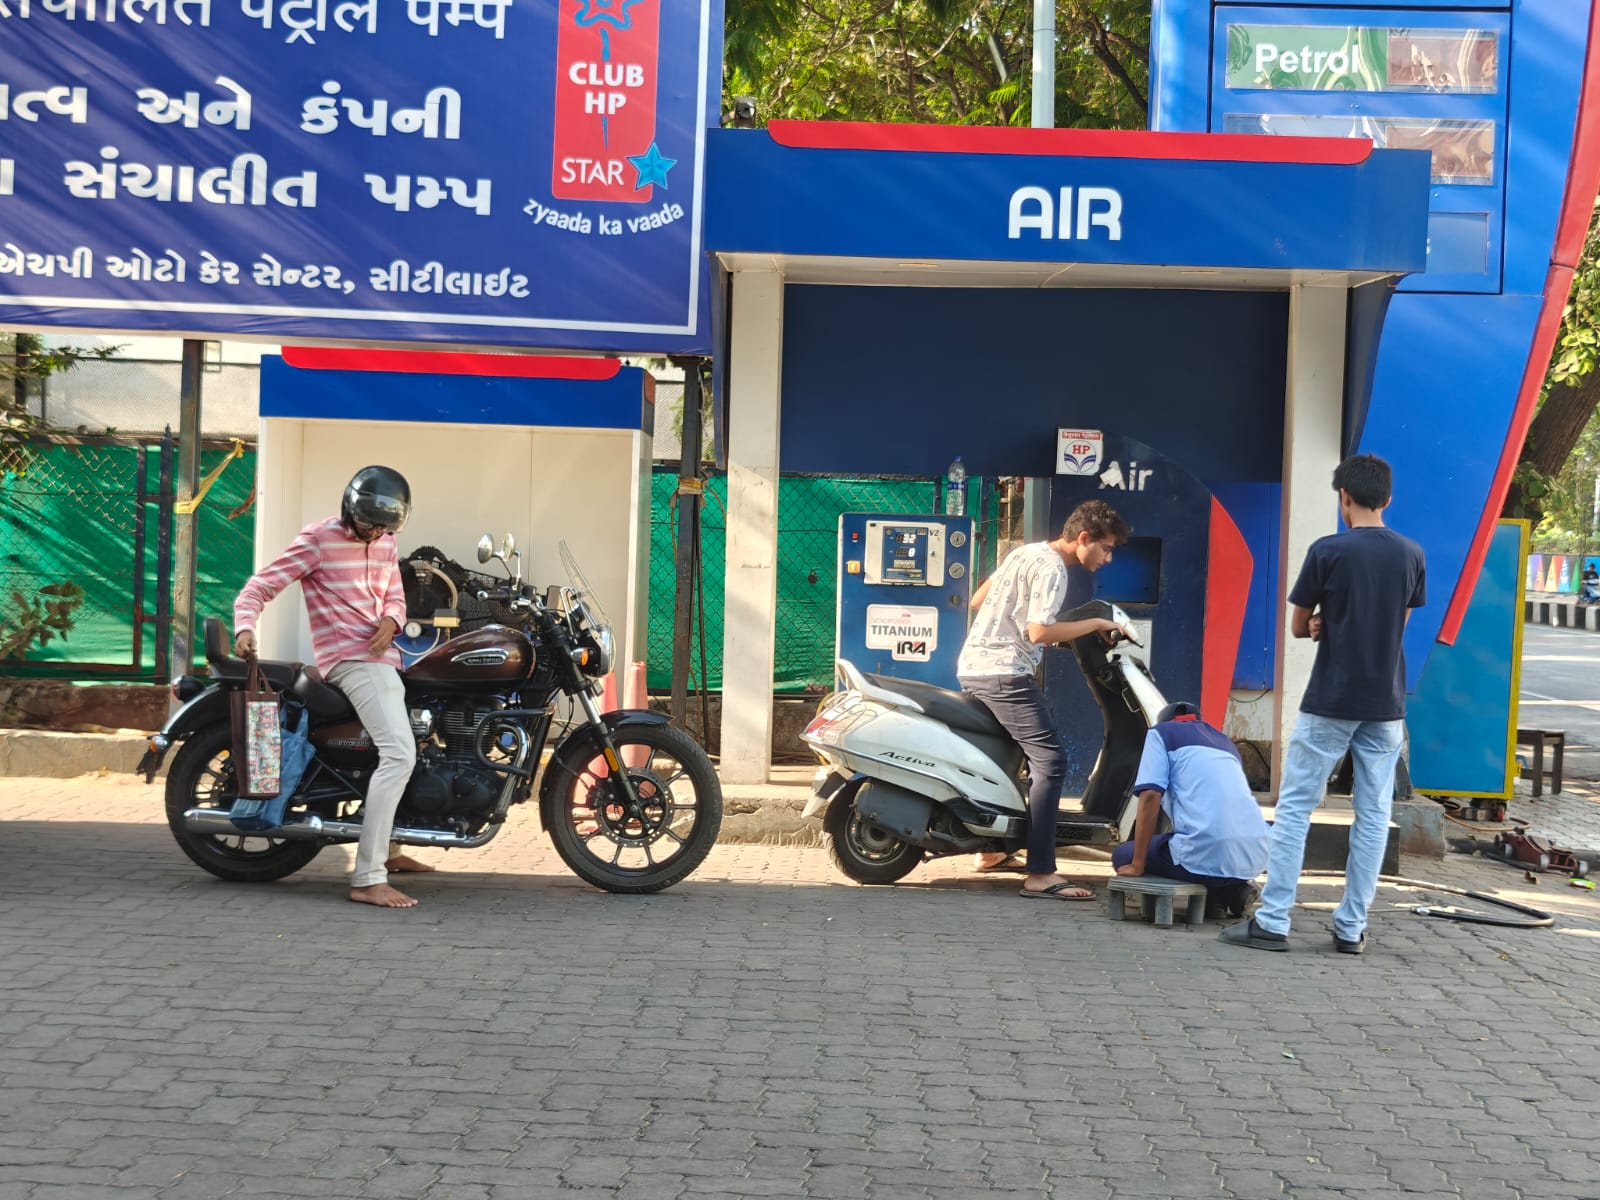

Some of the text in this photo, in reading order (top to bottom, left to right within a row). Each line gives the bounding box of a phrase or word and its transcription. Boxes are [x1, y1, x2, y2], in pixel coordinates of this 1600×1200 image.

[1255, 43, 1359, 73] Petrol
[568, 62, 645, 88] CLUB
[136, 75, 252, 130] અને
[300, 80, 461, 140] કંપની
[584, 91, 627, 115] HP
[63, 145, 318, 207] સંચાલીત
[364, 174, 492, 216] પમ્પ
[561, 157, 625, 186] STAR
[523, 198, 685, 235] zyaada ka vaada
[1008, 186, 1122, 241] AIR
[105, 247, 186, 283] ઓટો
[199, 250, 240, 286] કેર
[252, 252, 356, 295] સેન્ટર,
[369, 259, 531, 298] સીટીલાઈટ
[1072, 444, 1091, 455] HP
[1098, 461, 1153, 491] Air
[871, 624, 932, 637] TITANIUM
[896, 640, 926, 655] IRA
[878, 751, 937, 767] Activa
